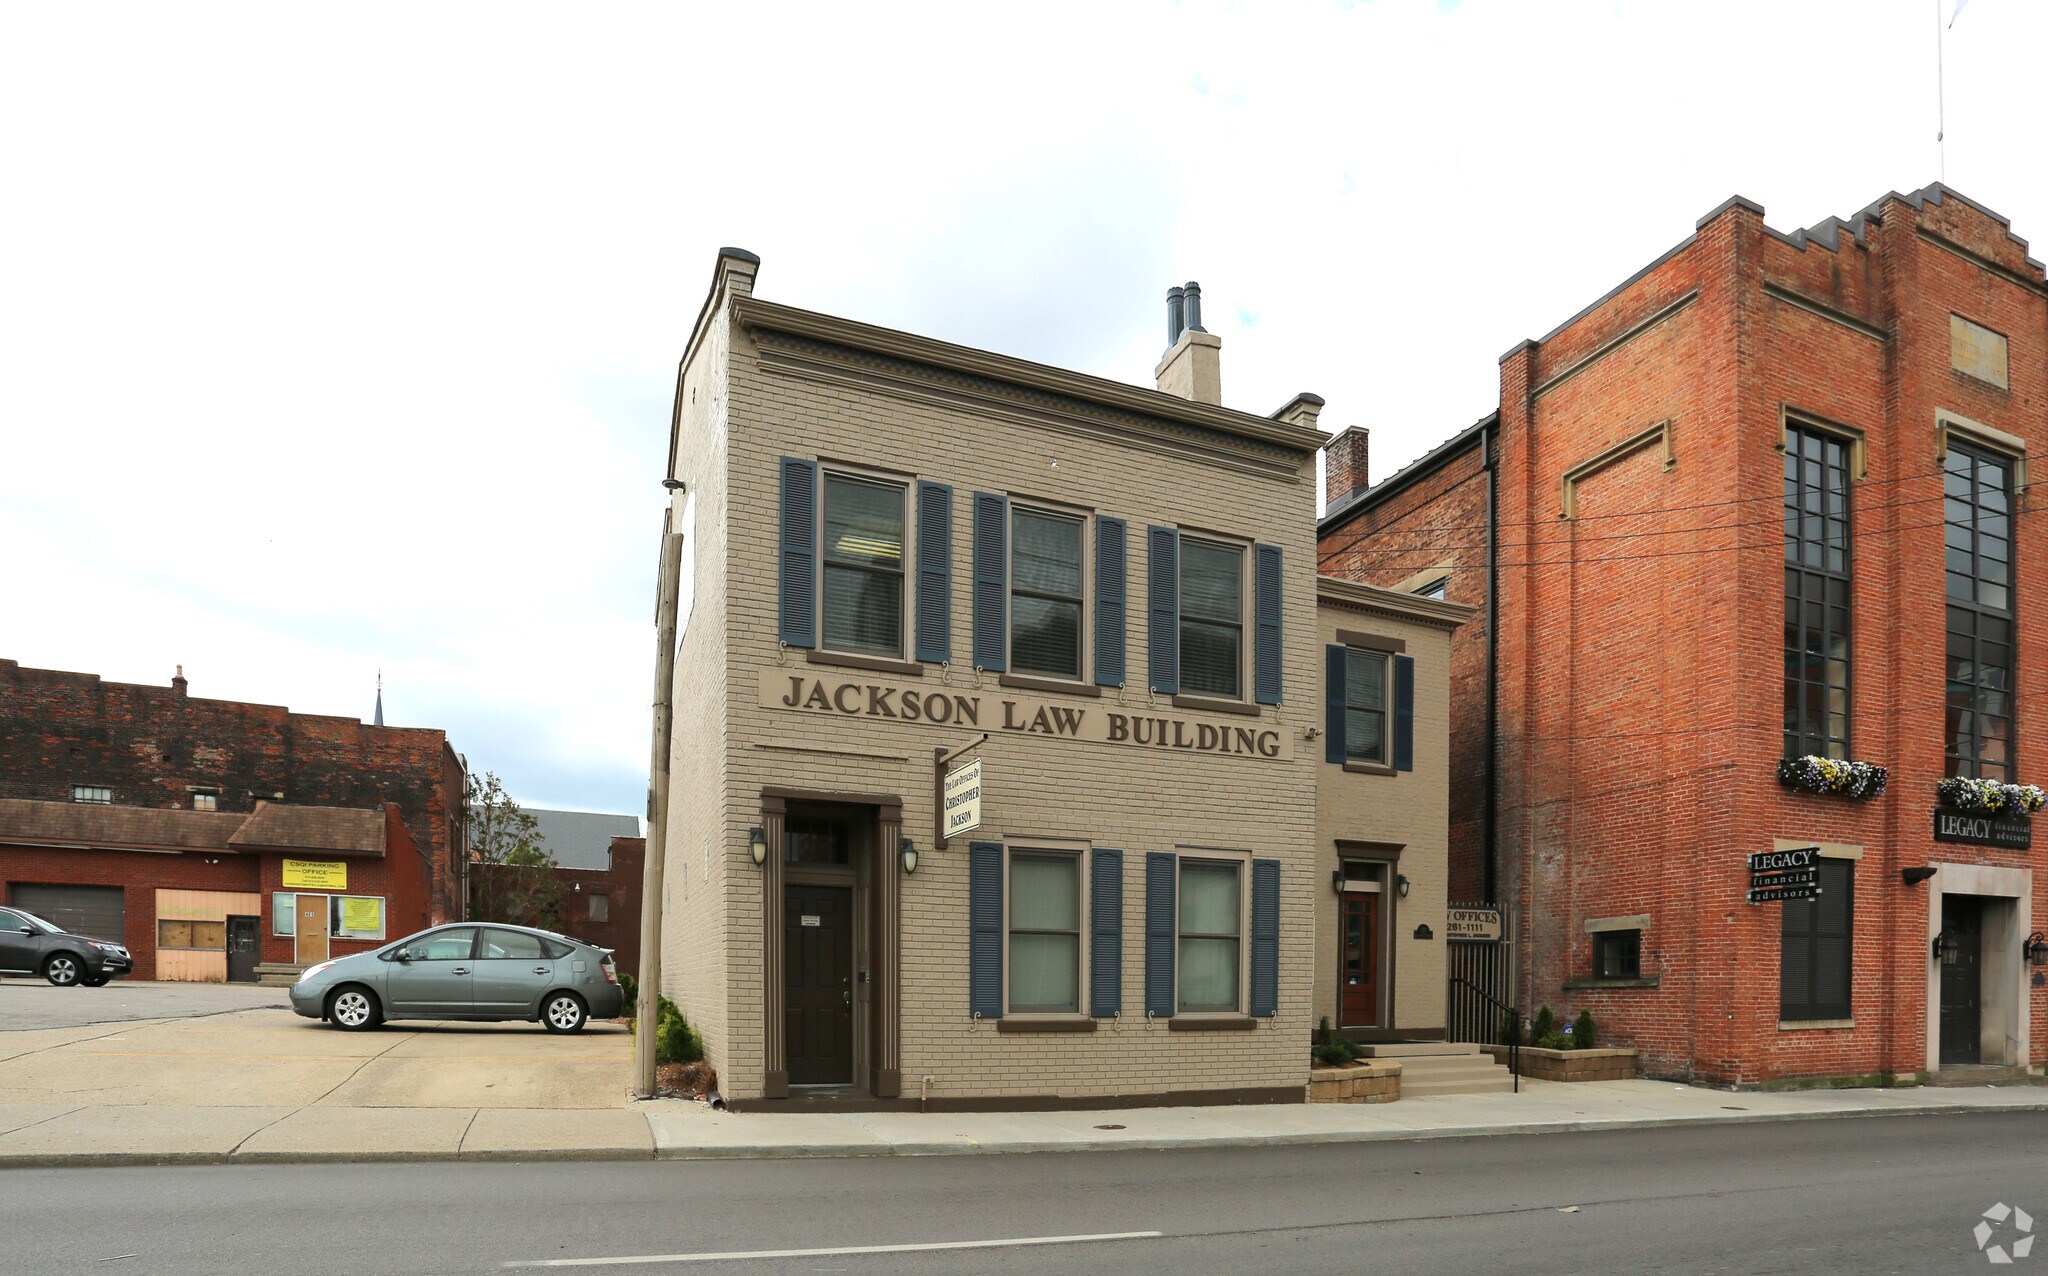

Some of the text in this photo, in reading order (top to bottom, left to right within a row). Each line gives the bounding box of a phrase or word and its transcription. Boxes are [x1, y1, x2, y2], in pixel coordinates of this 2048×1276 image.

[782, 676, 1281, 757] JACKSON LAW BUILDING
[946, 787, 979, 811] CHRISTOPHER
[951, 810, 971, 828] JACKSON
[1940, 815, 1992, 838] LEGACY
[1995, 821, 2030, 833] financial
[1996, 832, 2029, 842] advisors
[1754, 850, 1812, 870] LEGACY
[1753, 872, 1813, 886] financial
[1755, 889, 1810, 900] advisors
[1454, 911, 1497, 924] OFFICES
[1447, 923, 1482, 932] 261-1111
